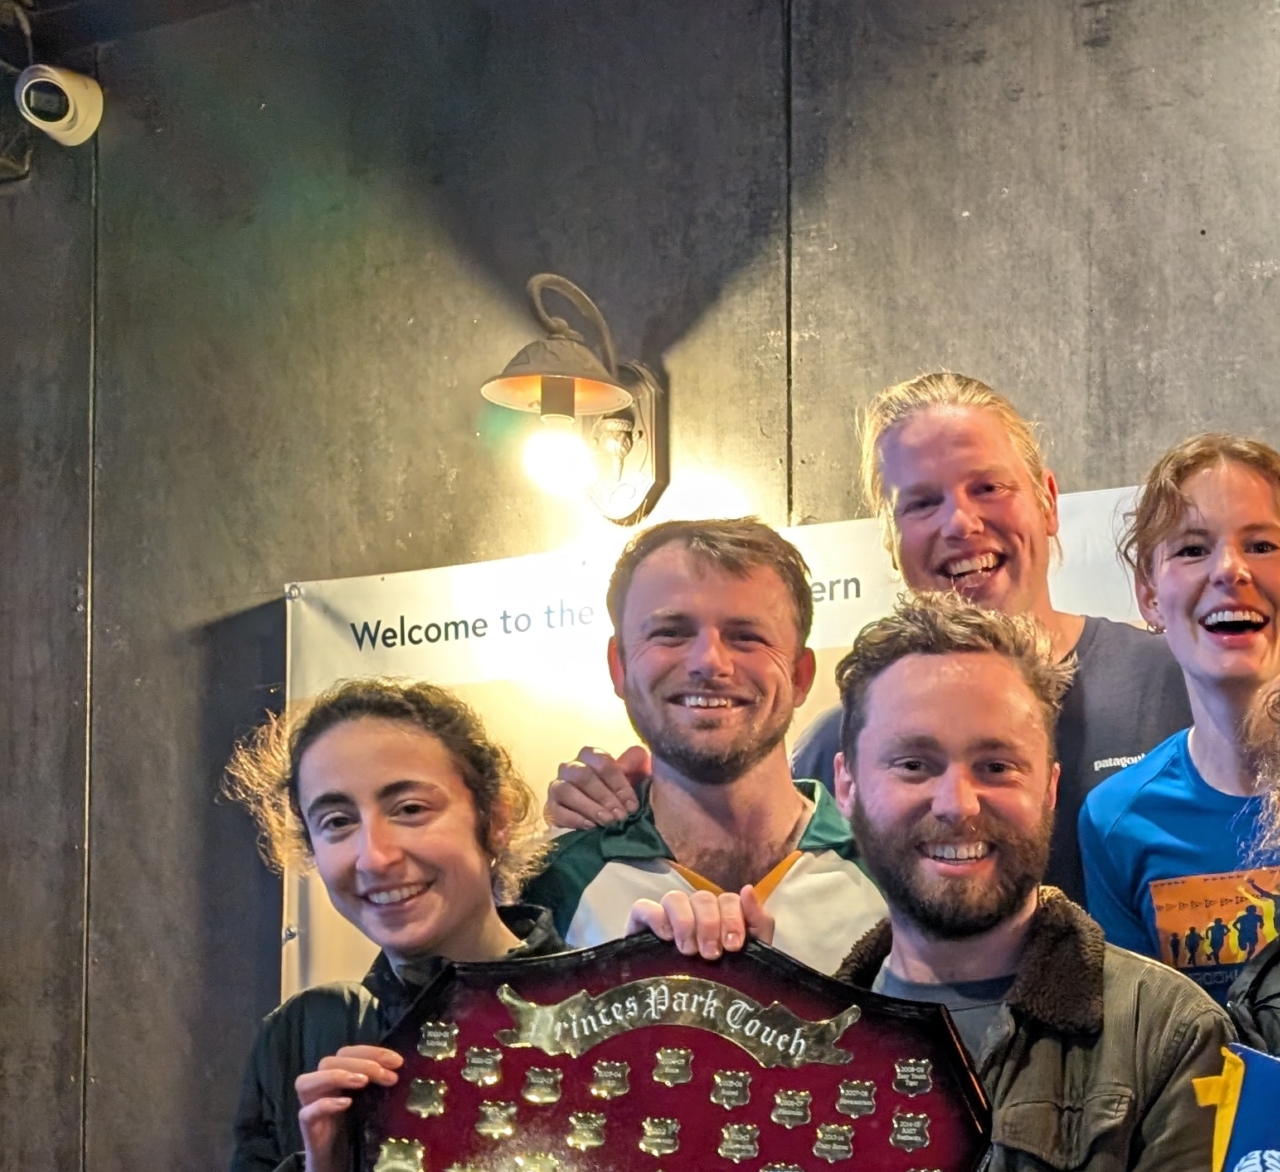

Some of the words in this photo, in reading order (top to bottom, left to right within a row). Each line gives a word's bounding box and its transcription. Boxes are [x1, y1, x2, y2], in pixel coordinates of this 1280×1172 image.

[350, 615, 488, 652] Welcome
[500, 610, 532, 635] to
[544, 599, 594, 629] the
[811, 577, 861, 603] ern
[642, 984, 718, 1020] Park
[726, 999, 807, 1059] Touch
